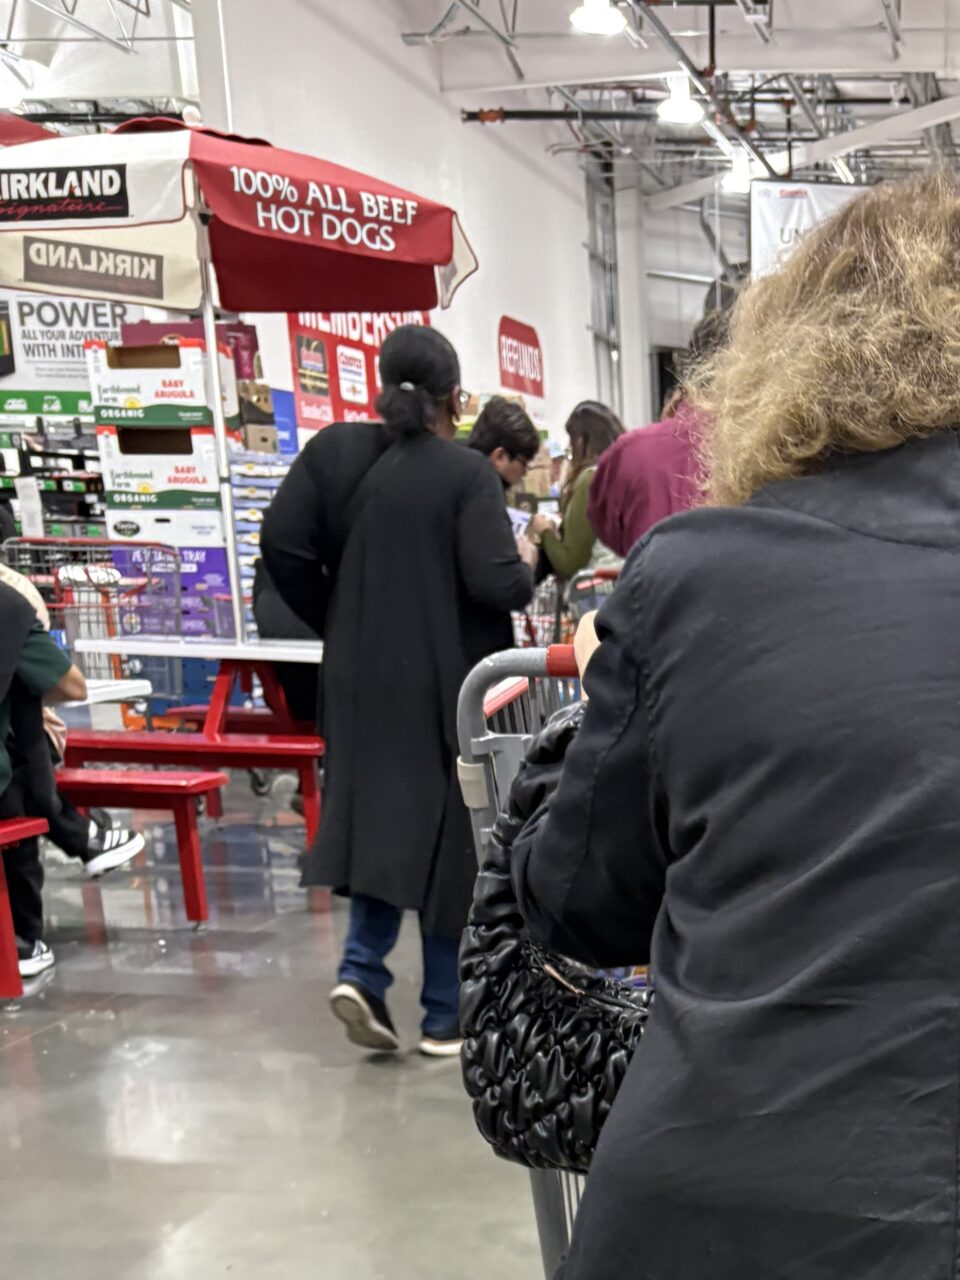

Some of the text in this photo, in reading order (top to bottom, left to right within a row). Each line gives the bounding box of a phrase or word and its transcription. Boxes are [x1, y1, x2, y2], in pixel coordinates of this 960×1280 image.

[0, 169, 121, 200] IRKLAND
[230, 165, 418, 226] 100% ALL BEEF
[256, 200, 396, 252] HOT DOGS
[17, 301, 128, 328] POWER
[21, 329, 38, 341] ALL
[39, 330, 67, 341] YOUR
[22, 343, 87, 359] WITH INT
[100, 408, 145, 418] ORGANIC
[112, 494, 158, 503] ORGANIC
